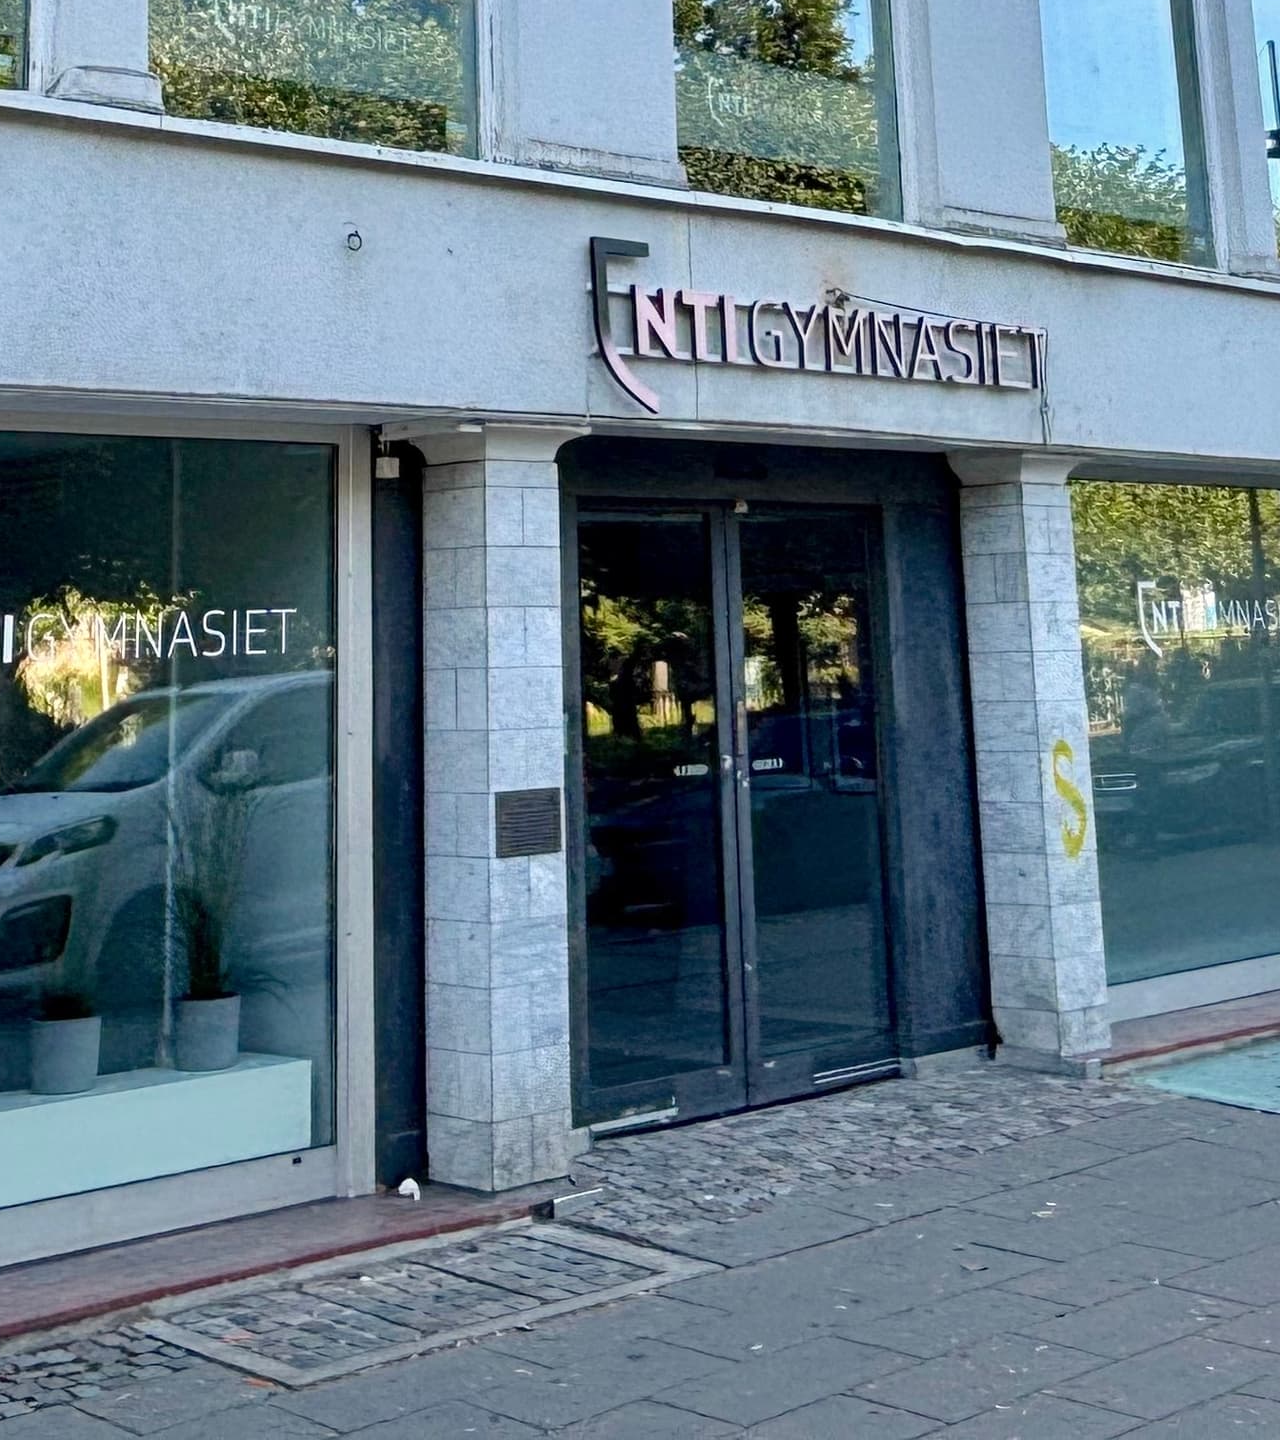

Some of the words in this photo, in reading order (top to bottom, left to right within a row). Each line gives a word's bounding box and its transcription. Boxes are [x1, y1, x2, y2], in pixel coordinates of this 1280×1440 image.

[630, 283, 738, 364] NTI
[747, 297, 1049, 390] GYMNASIET
[25, 606, 298, 663] GYMNASIET
